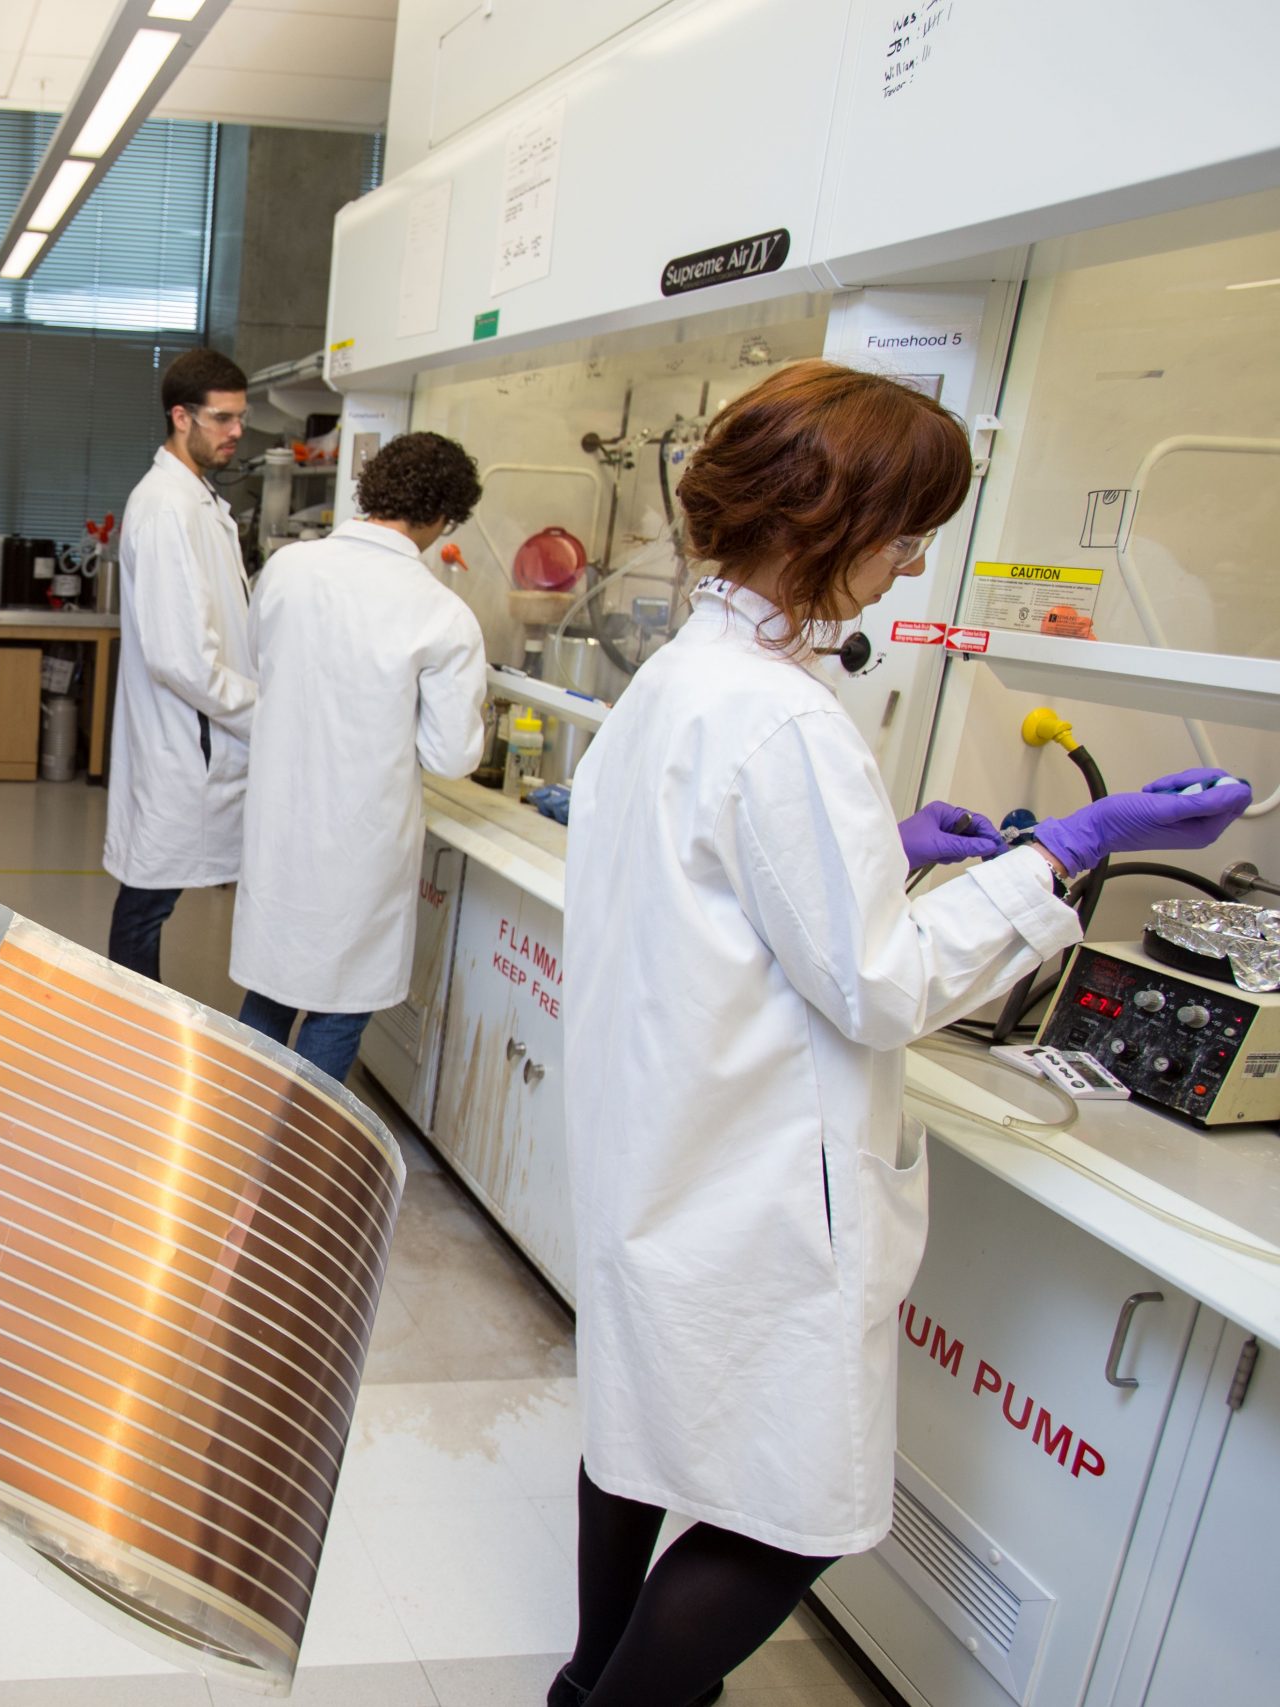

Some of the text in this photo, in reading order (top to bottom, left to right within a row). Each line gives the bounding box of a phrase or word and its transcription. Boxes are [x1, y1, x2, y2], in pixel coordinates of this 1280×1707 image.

[665, 256, 725, 287] Supreme
[867, 333, 963, 348] Fumehood 5
[1010, 566, 1061, 580] CAUTION
[420, 878, 444, 909] UMP
[492, 952, 527, 986] KEEP
[973, 1359, 1106, 1479] PUMP
